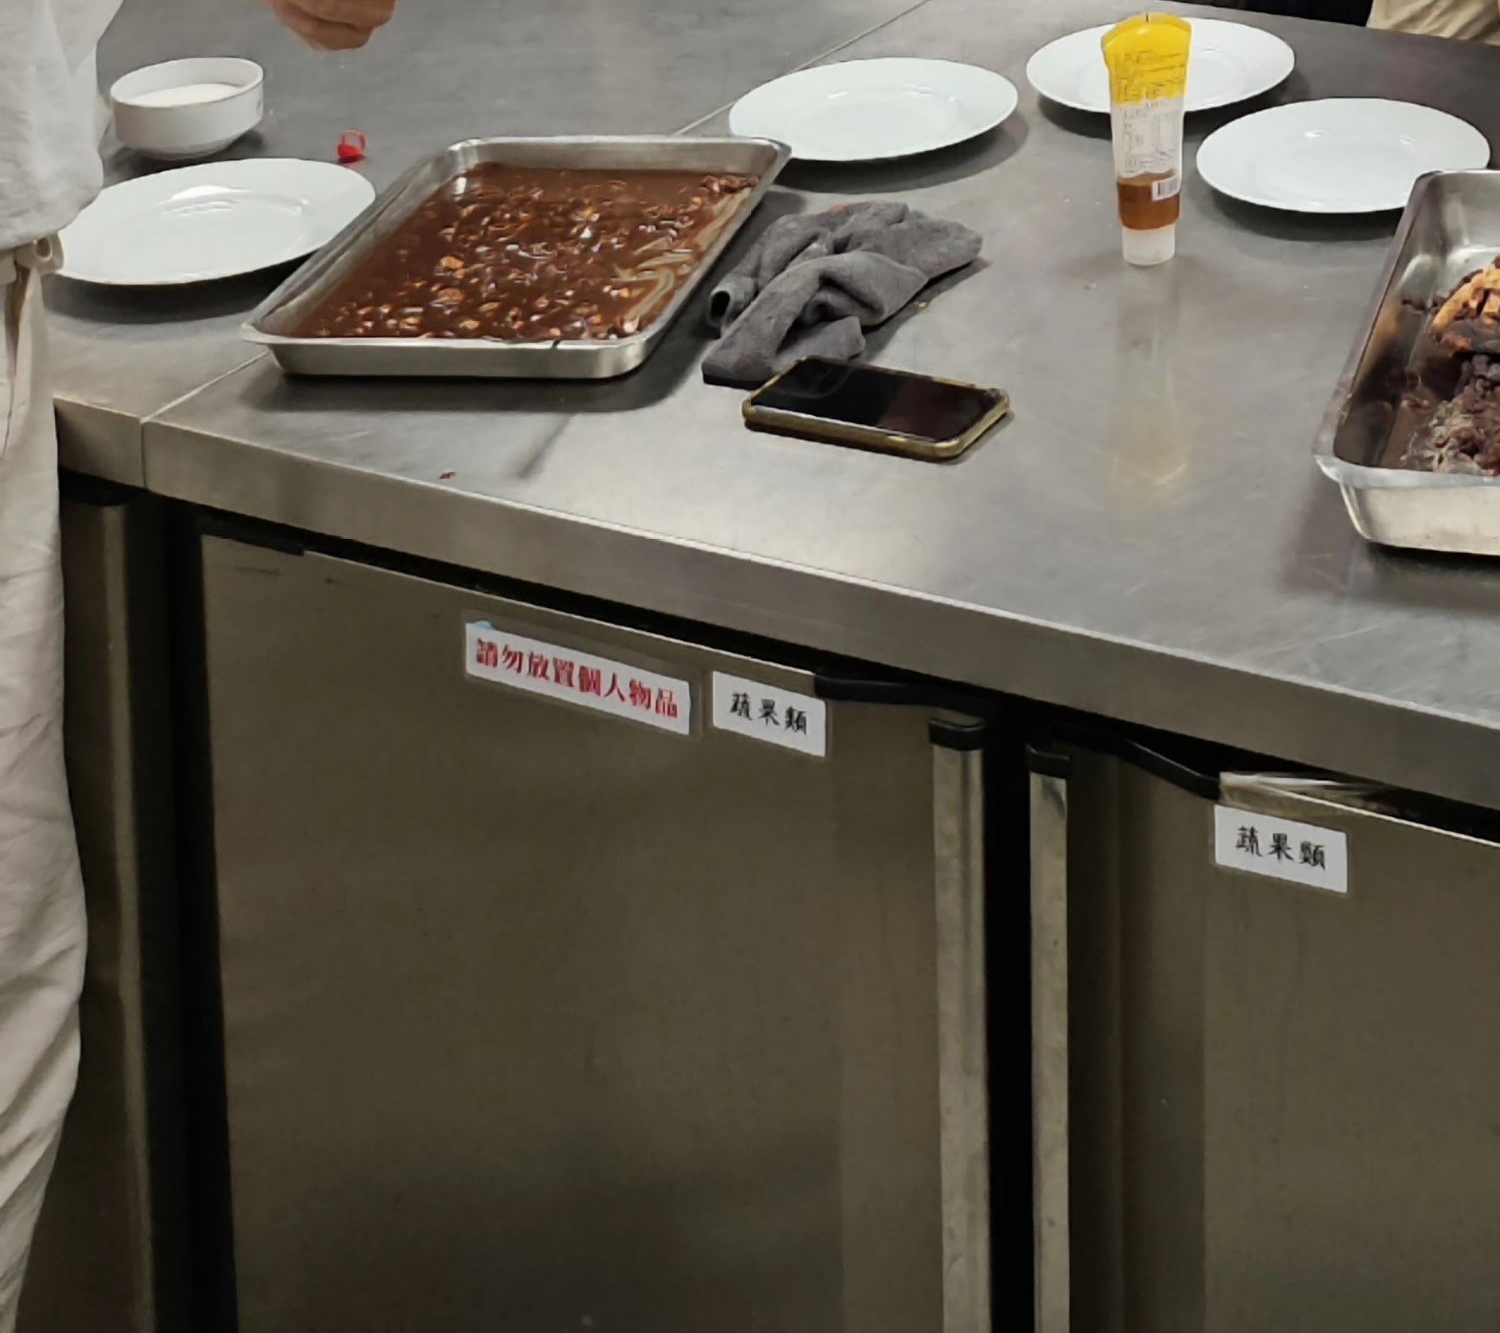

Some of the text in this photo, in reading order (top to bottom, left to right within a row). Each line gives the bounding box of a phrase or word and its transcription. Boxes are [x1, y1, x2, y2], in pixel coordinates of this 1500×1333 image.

[475, 637, 679, 719] 請勿放置個人物品
[729, 691, 808, 736] 蔬果類
[1234, 824, 1327, 870] 蔬果類
